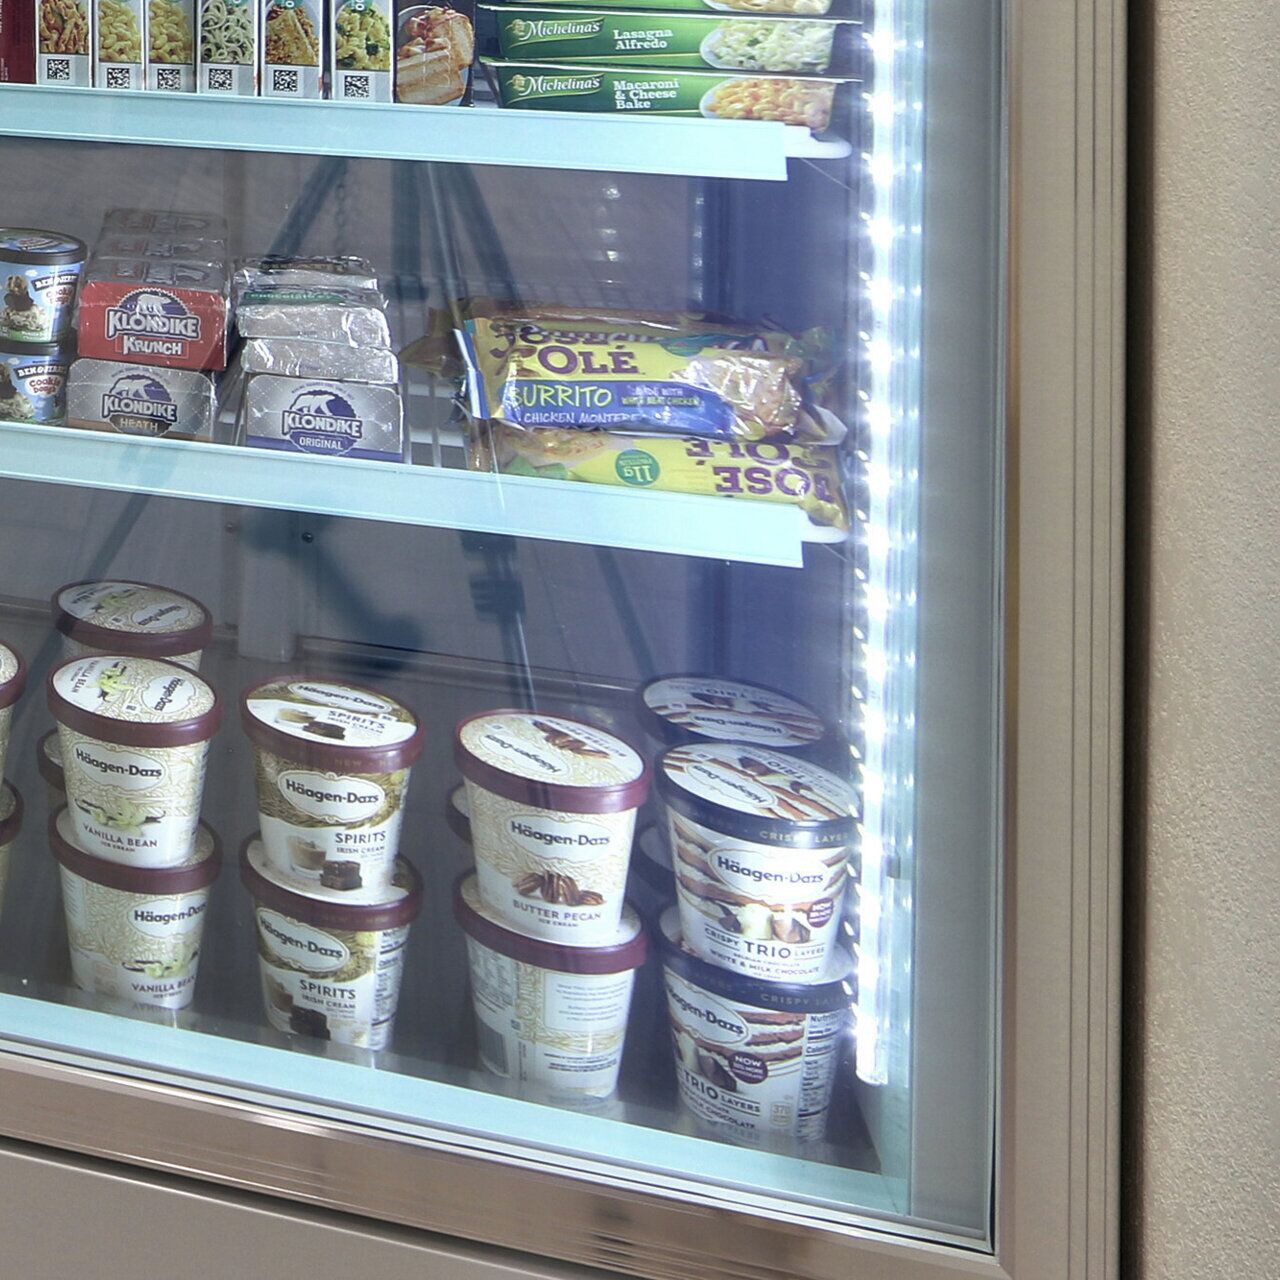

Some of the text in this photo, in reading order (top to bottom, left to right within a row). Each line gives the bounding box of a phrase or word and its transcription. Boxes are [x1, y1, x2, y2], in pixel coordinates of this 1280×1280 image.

[613, 27, 673, 41] Lasagna
[615, 37, 668, 50] Alfredo
[613, 79, 679, 92] Macaroni
[629, 88, 678, 101] Cheese
[107, 310, 201, 339] KLONDIKE
[122, 336, 182, 355] KRUNCH
[537, 344, 640, 375] OLÉ
[510, 384, 613, 408] BURRITO
[102, 397, 177, 421] KLONDIKE
[120, 418, 158, 431] HEATH
[283, 411, 362, 437] KLONDIKE
[299, 436, 344, 451] ORIGINAL
[76, 749, 162, 778] Häagen-Dazs
[285, 779, 379, 805] Häagen-Dazs
[83, 825, 124, 847] VANILLA
[335, 832, 386, 844] SPIRITS
[511, 821, 610, 847] Häagen-Dazs
[513, 899, 601, 921] BUTTER PECAN
[704, 927, 790, 960] CRISPY TRIO
[300, 979, 355, 1000] SPIRITS
[683, 1070, 760, 1113] TRIO LAYERS
